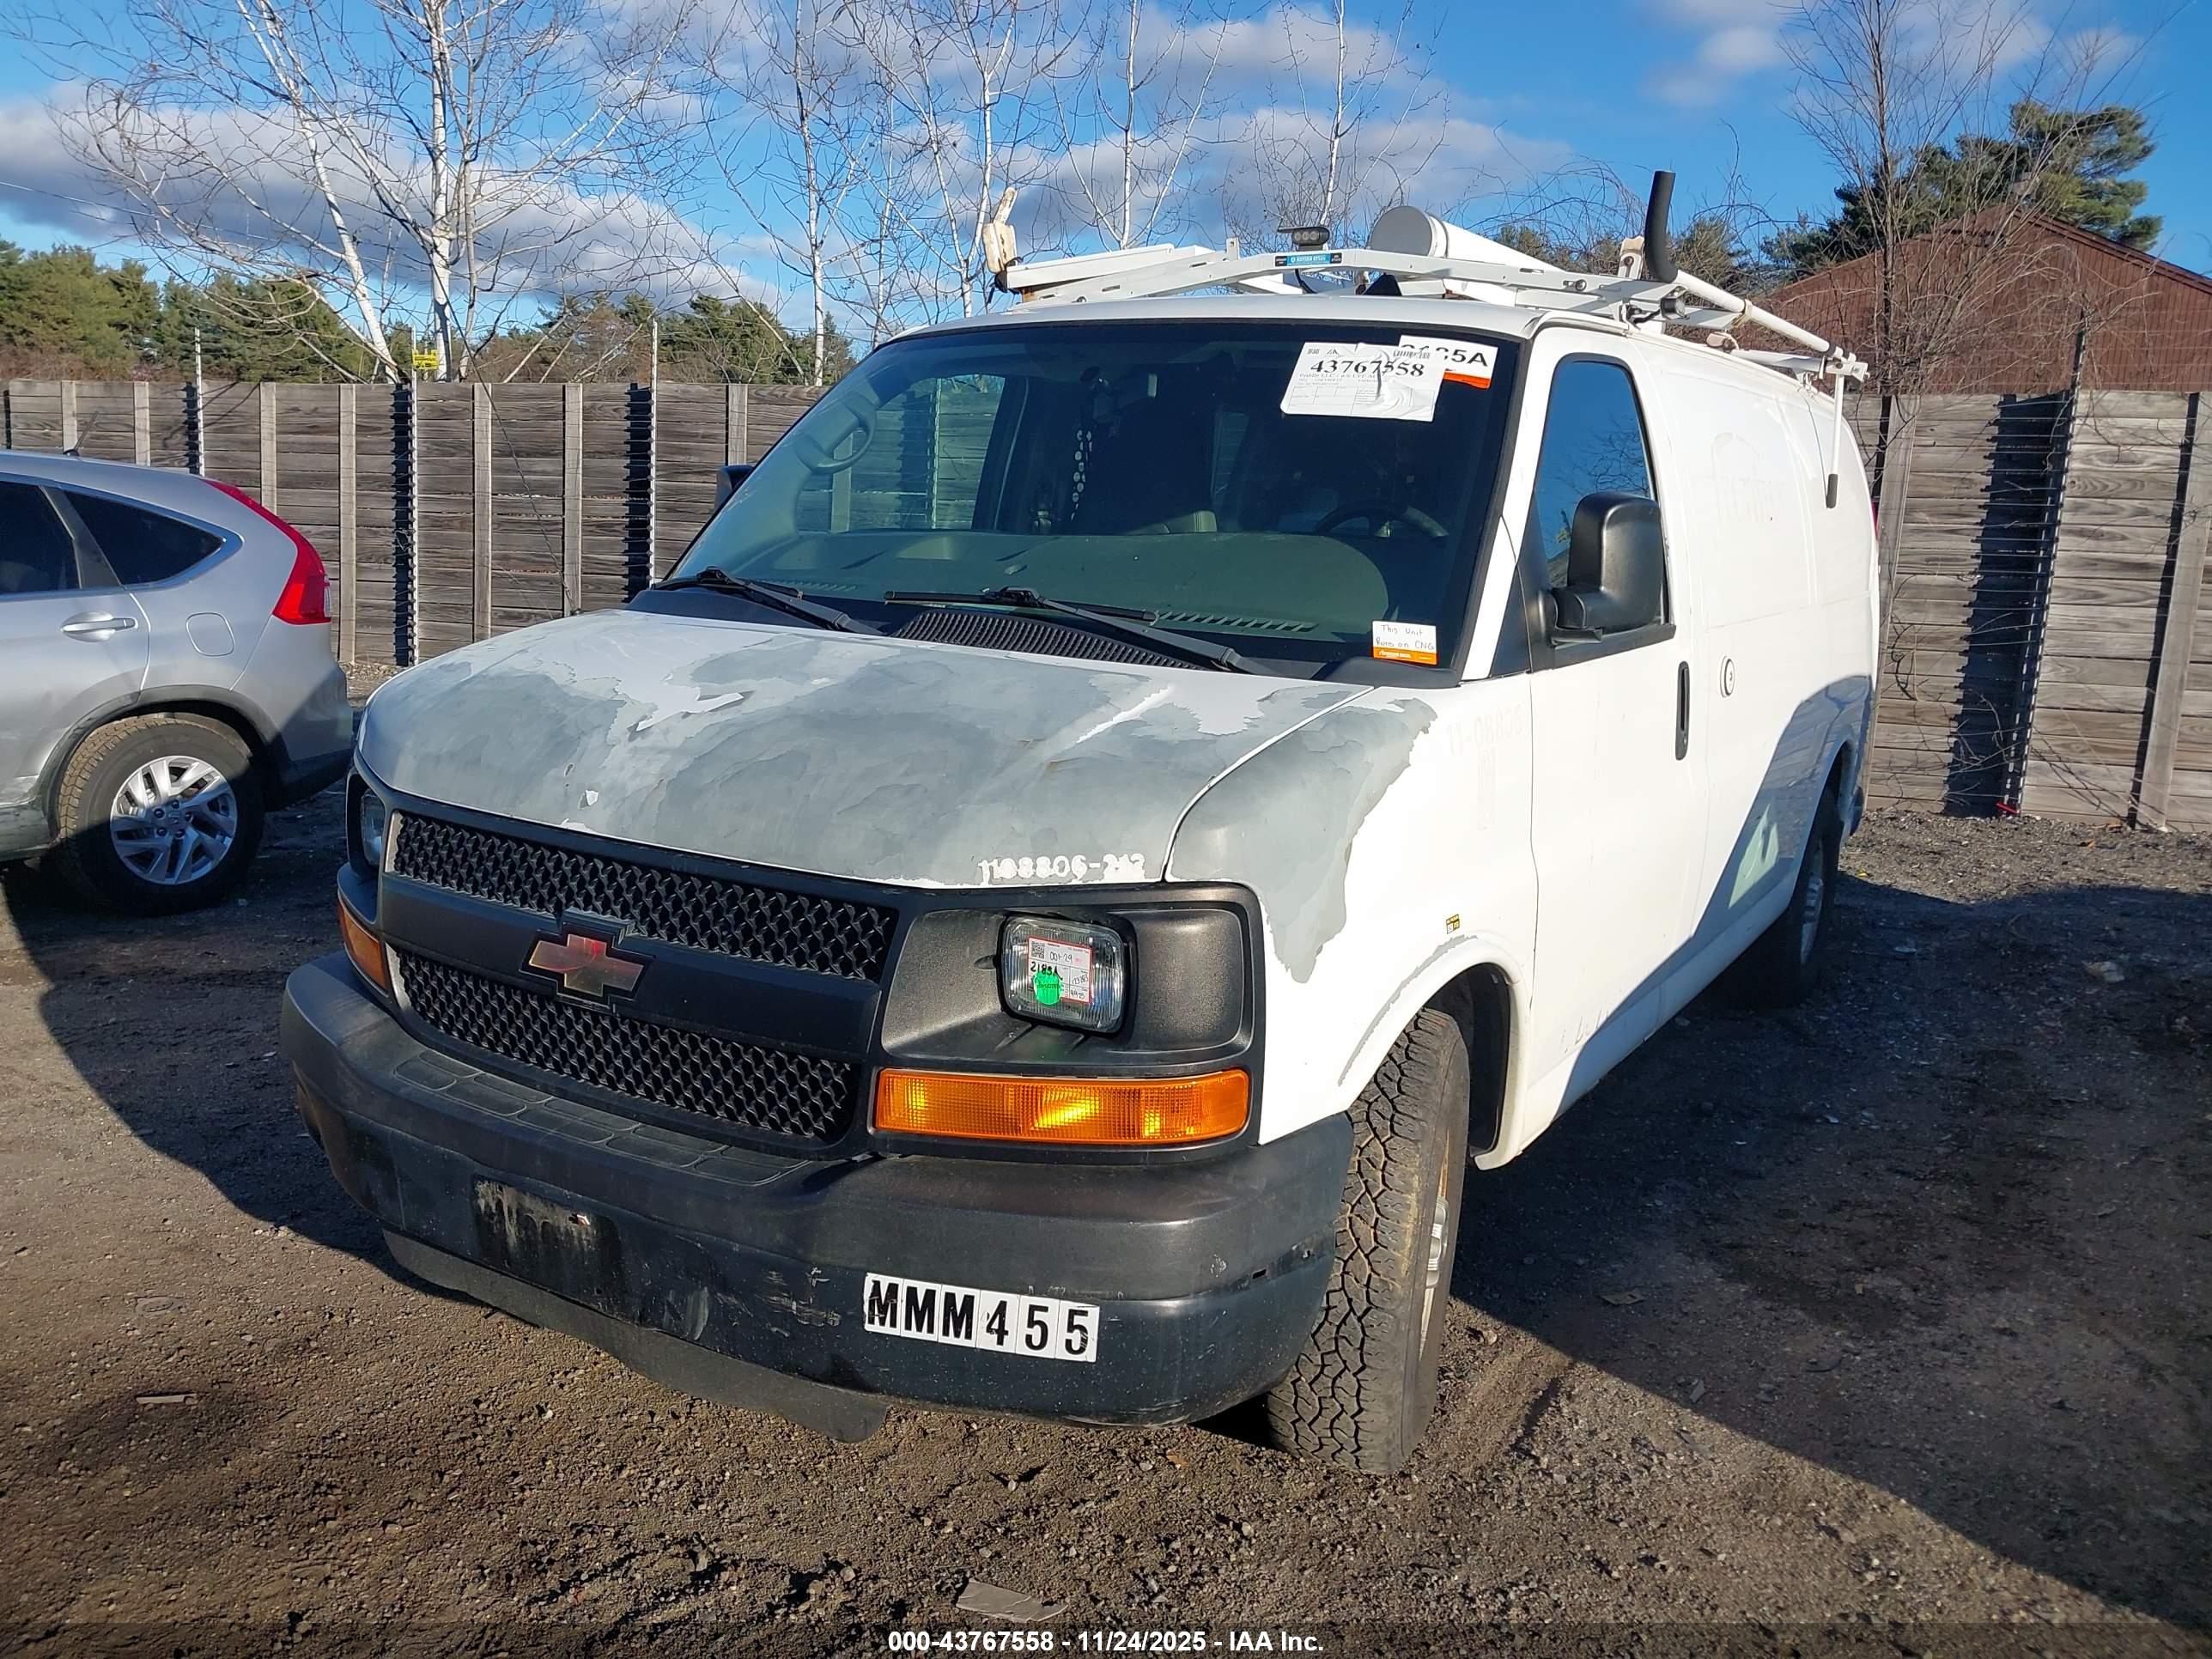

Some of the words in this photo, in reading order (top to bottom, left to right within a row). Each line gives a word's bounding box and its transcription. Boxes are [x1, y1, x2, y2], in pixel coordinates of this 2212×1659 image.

[1310, 359, 1425, 378] 43767558
[1380, 624, 1398, 634] This
[1405, 628, 1423, 636] Unit
[1376, 636, 1395, 647] Runs
[1414, 640, 1435, 650] CNG
[867, 1279, 1089, 1355] MMM455
